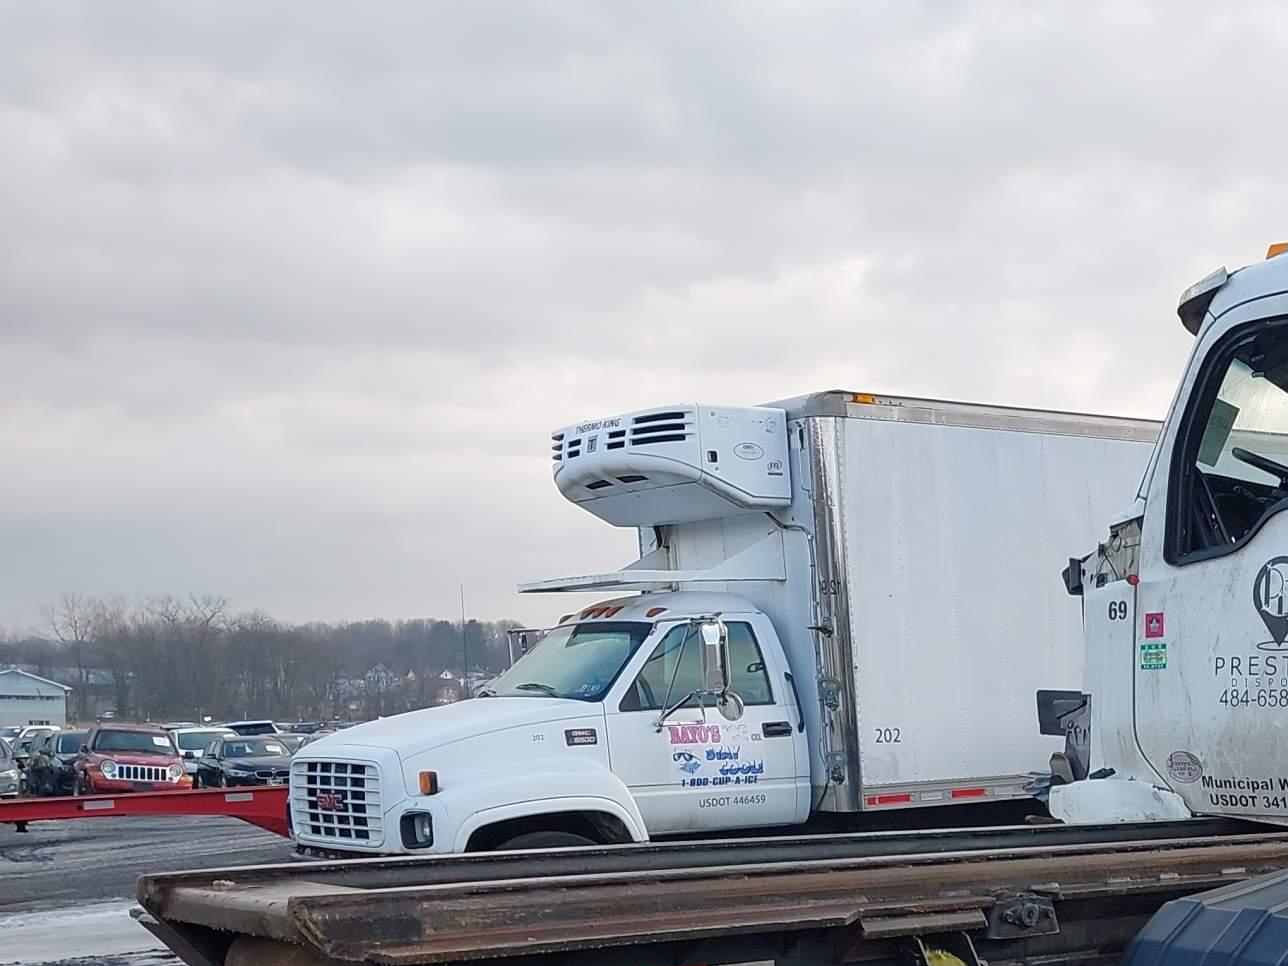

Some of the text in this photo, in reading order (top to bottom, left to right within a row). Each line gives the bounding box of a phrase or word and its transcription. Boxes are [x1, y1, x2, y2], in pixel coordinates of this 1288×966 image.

[602, 417, 622, 429] KING
[1108, 600, 1127, 620] 69
[875, 728, 901, 743] 202
[1202, 776, 1274, 793] Municipal
[316, 793, 343, 809] GMC
[699, 794, 766, 808] USDOT 446459
[1210, 794, 1257, 807] USDOT
